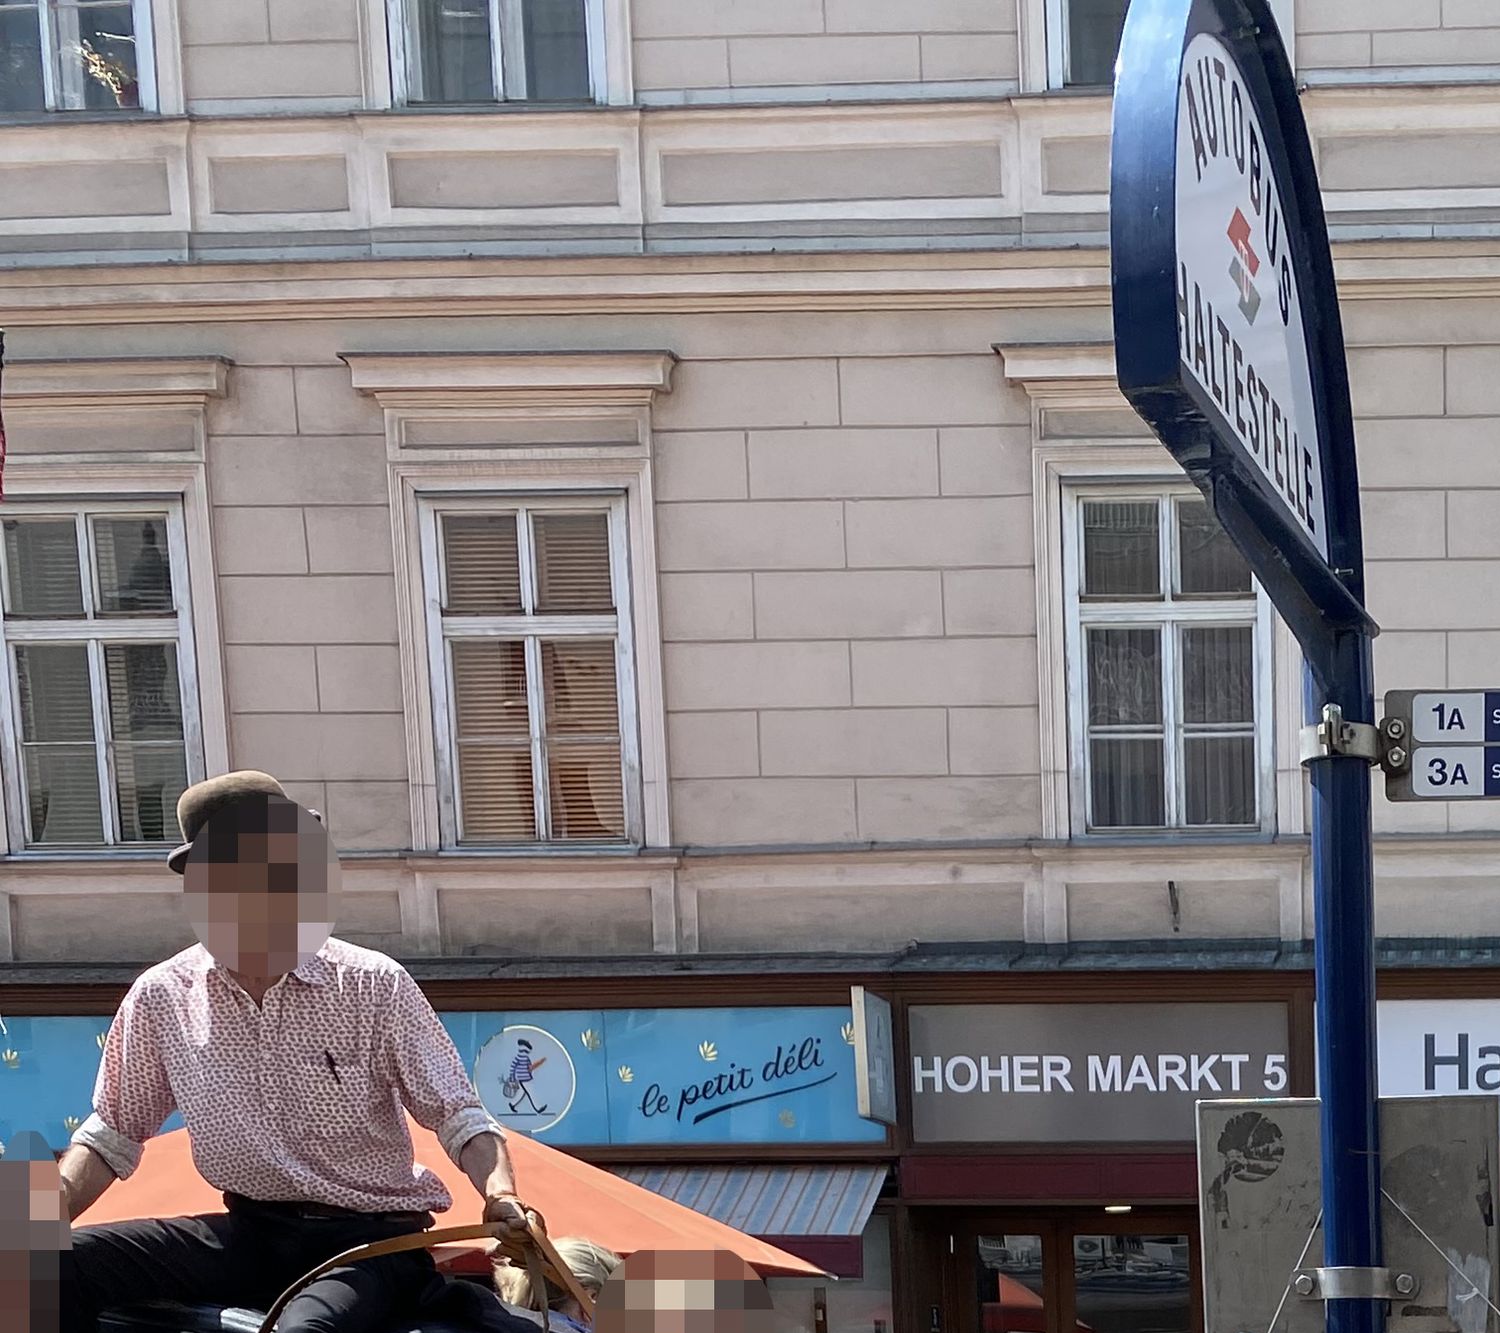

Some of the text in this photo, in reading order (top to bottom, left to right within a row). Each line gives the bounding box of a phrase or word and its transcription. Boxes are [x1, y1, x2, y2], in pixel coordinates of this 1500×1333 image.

[1185, 55, 1292, 327] AUTOBUS
[1178, 261, 1315, 535] HALTESTELLE
[1431, 703, 1465, 731] 1A
[1427, 758, 1469, 786] 3A
[639, 1083, 670, 1118] le
[676, 1062, 754, 1122] petit
[761, 1036, 824, 1083] déli
[913, 1053, 1288, 1093] HOHER MARKT 5
